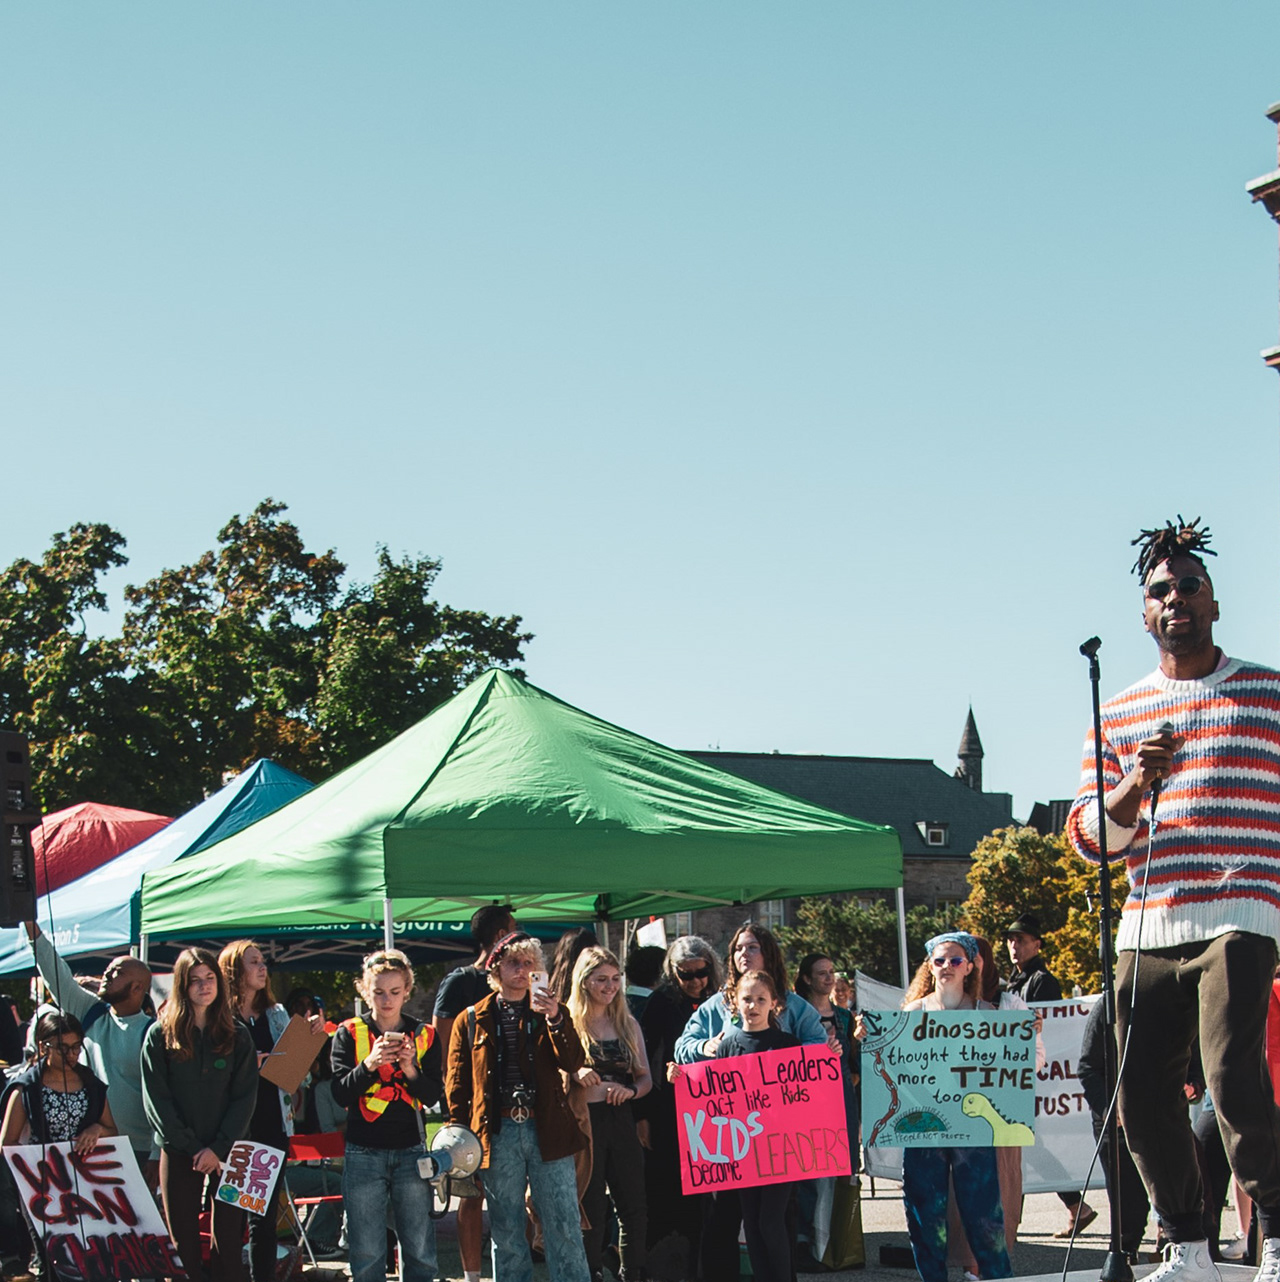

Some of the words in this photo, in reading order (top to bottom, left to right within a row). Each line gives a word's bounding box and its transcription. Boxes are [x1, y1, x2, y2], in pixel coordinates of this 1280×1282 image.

[913, 1012, 1033, 1041] dinosaurs
[686, 1066, 746, 1099] When
[758, 1047, 840, 1086] Leaders
[888, 1046, 949, 1070] thought
[959, 1045, 996, 1066] they
[1003, 1045, 1029, 1061] had
[898, 1073, 936, 1086] more
[950, 1066, 1034, 1090] TIME
[706, 1095, 735, 1117] act
[933, 1089, 961, 1104] too
[11, 1144, 125, 1195] WE
[225, 1144, 255, 1188] HOME
[246, 1149, 279, 1198] SAVE
[687, 1150, 742, 1187] become
[753, 1128, 850, 1178] LEADERS
[29, 1186, 138, 1227] CAN
[239, 1194, 266, 1215] OUR
